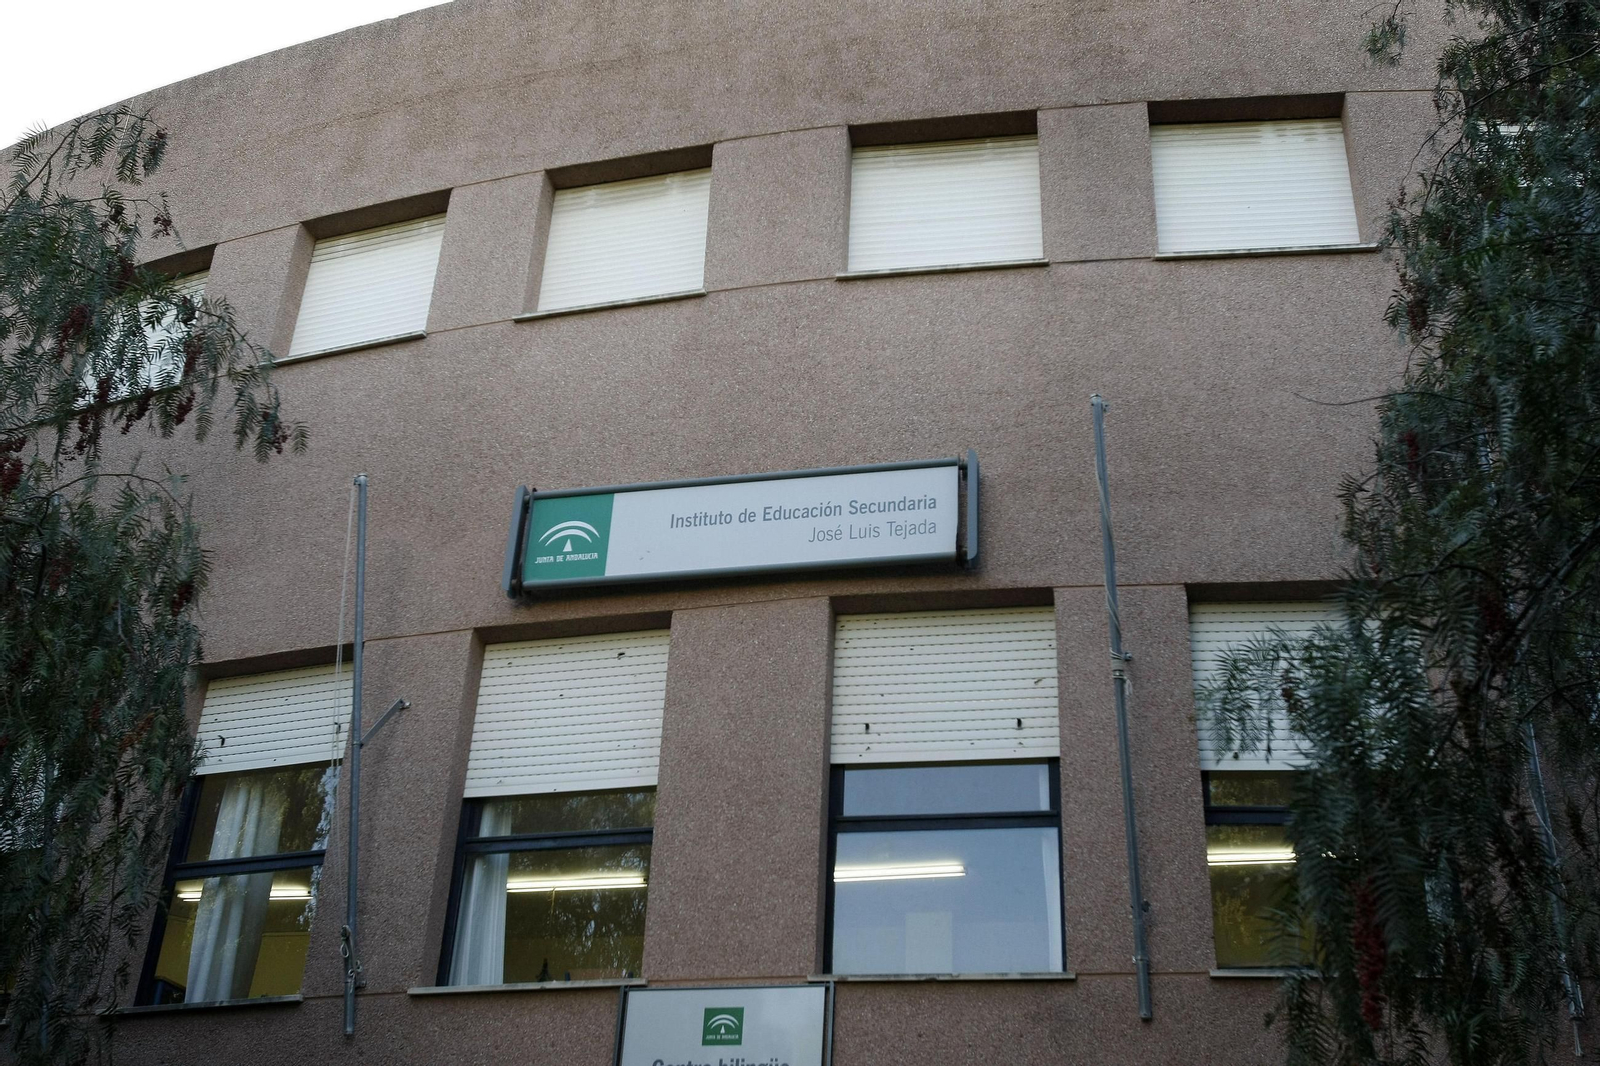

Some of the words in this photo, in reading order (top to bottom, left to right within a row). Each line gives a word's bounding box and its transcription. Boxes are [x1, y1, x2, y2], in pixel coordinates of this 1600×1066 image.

[670, 512, 732, 529] Instituto
[738, 508, 757, 523] de
[762, 502, 842, 521] Educación
[848, 494, 937, 515] Secundaria
[808, 525, 843, 543] José
[849, 524, 881, 539] Luis
[887, 519, 937, 539] Tejada
[534, 556, 554, 564] JUNTA
